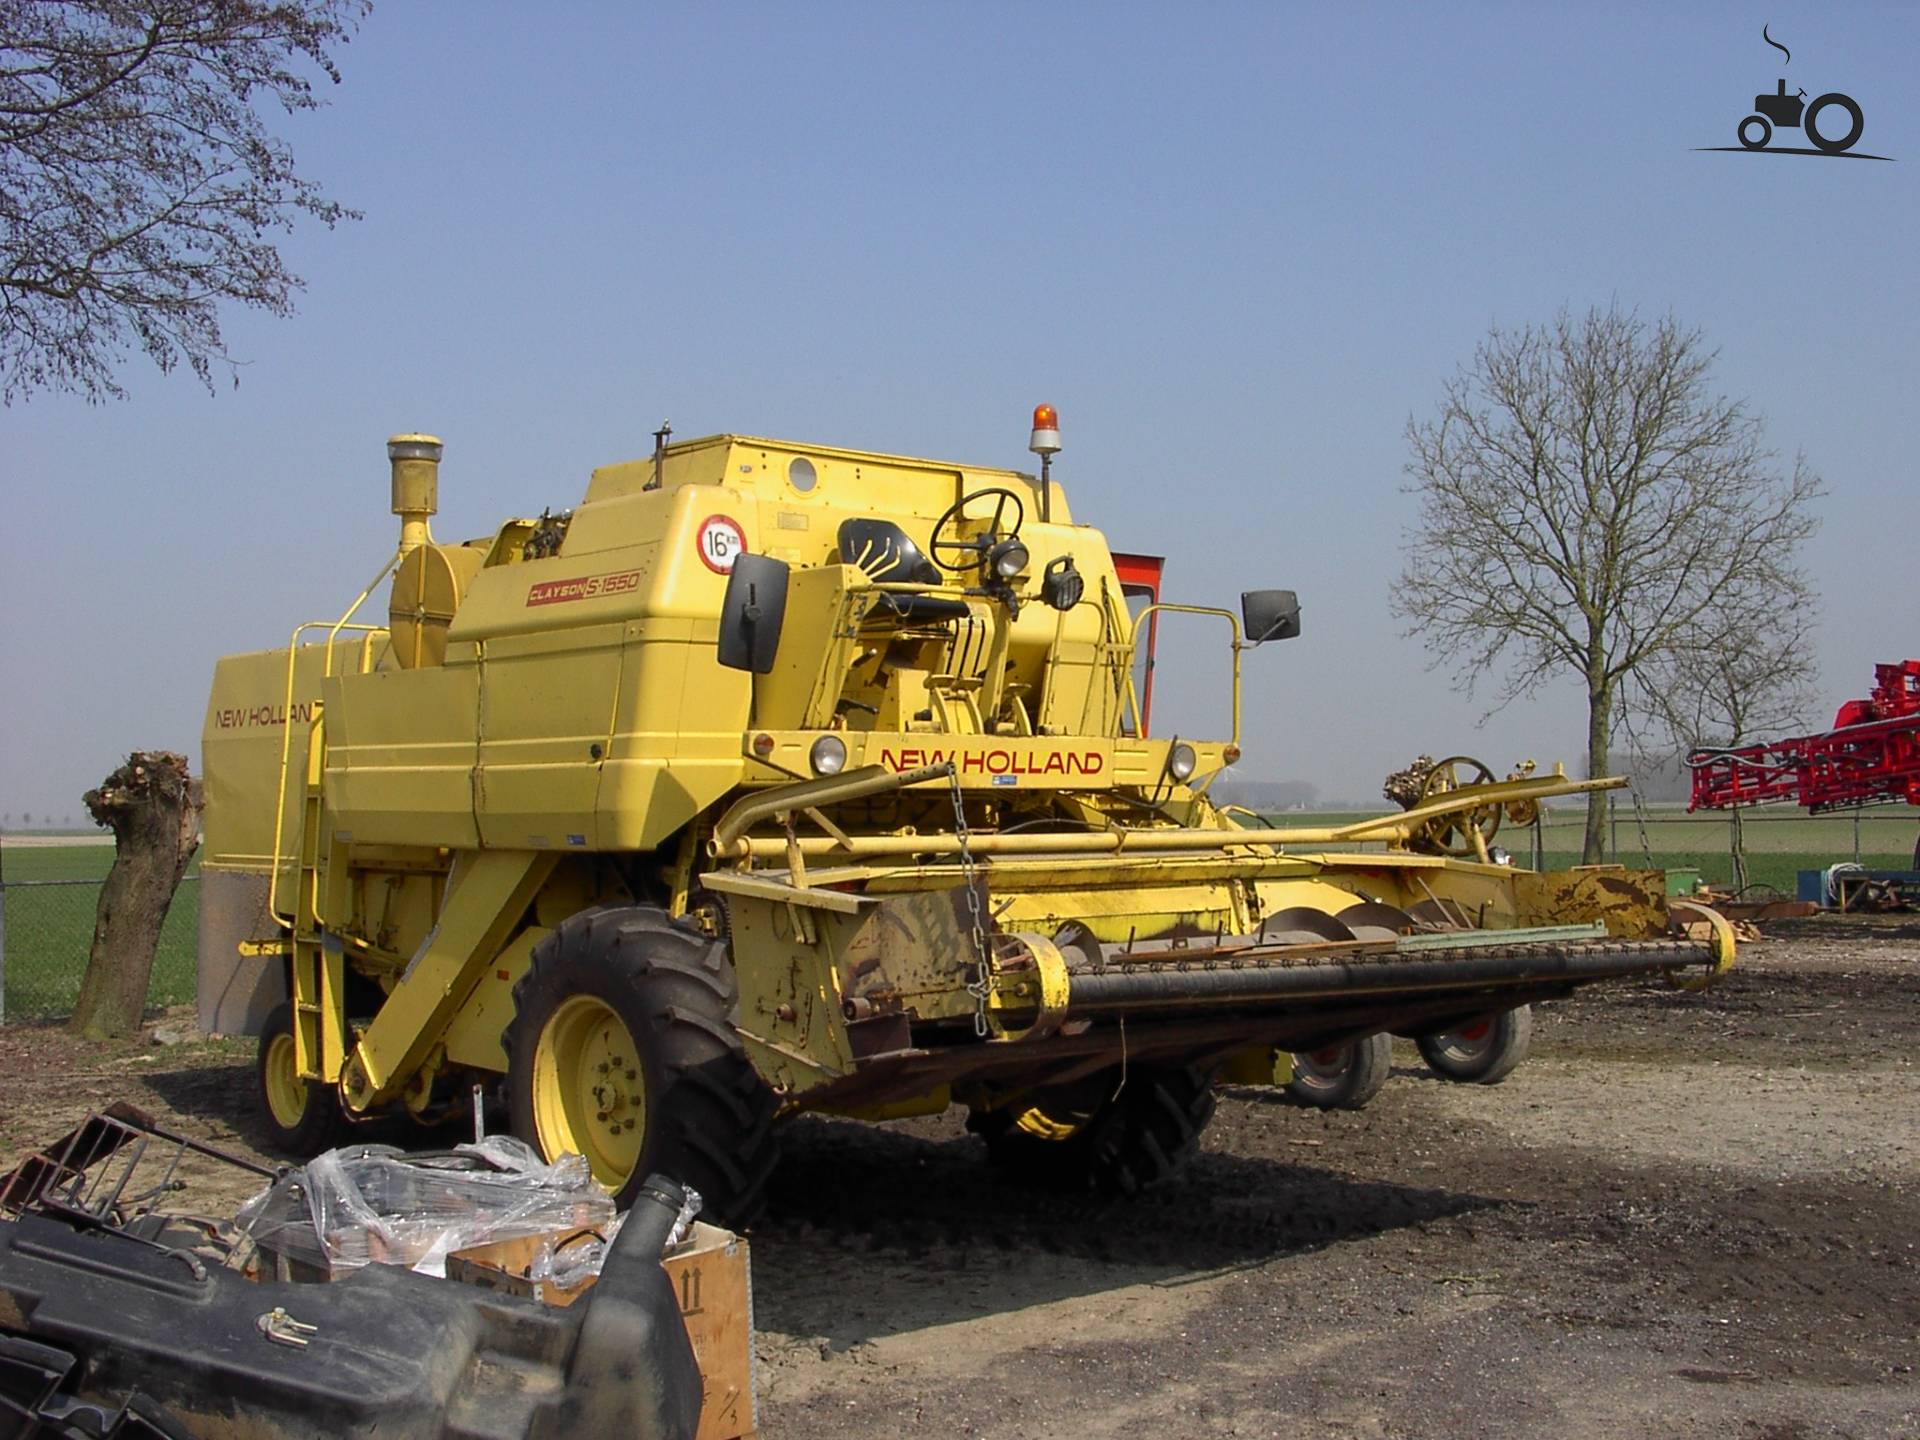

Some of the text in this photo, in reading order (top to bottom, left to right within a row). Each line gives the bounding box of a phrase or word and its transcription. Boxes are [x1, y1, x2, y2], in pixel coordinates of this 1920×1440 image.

[708, 530, 728, 557] 16
[529, 582, 587, 601] CLAYSON
[215, 703, 312, 729] NEW HOLLAN
[963, 750, 1103, 775] HOLLAND
